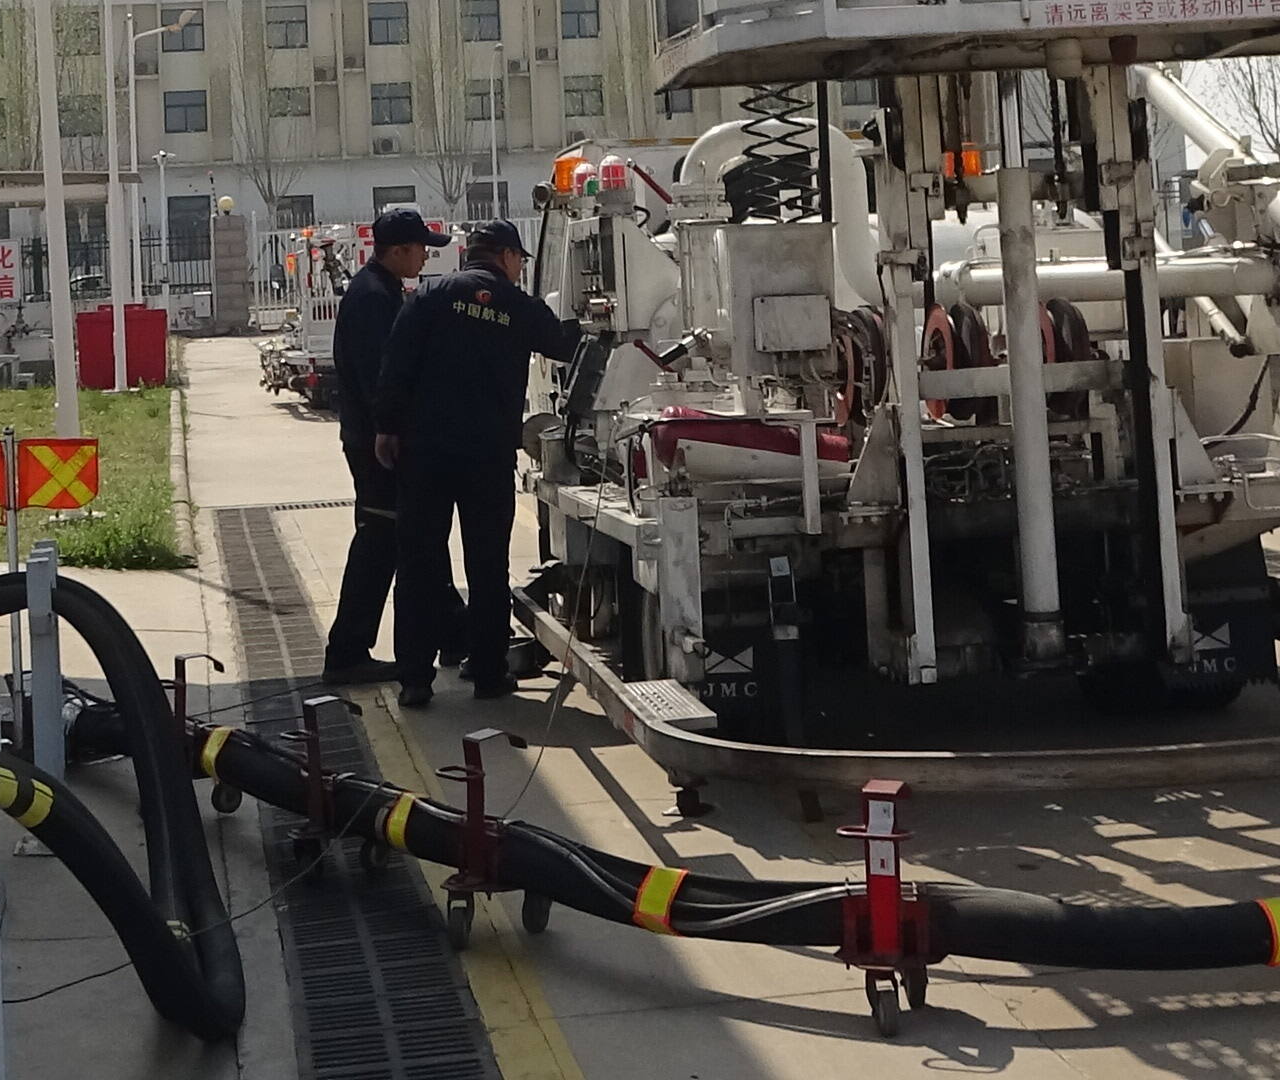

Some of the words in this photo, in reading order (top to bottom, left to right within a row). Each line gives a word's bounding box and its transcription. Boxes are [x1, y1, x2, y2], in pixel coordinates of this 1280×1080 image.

[454, 300, 510, 326] 中国航油
[704, 682, 757, 697] JMC
